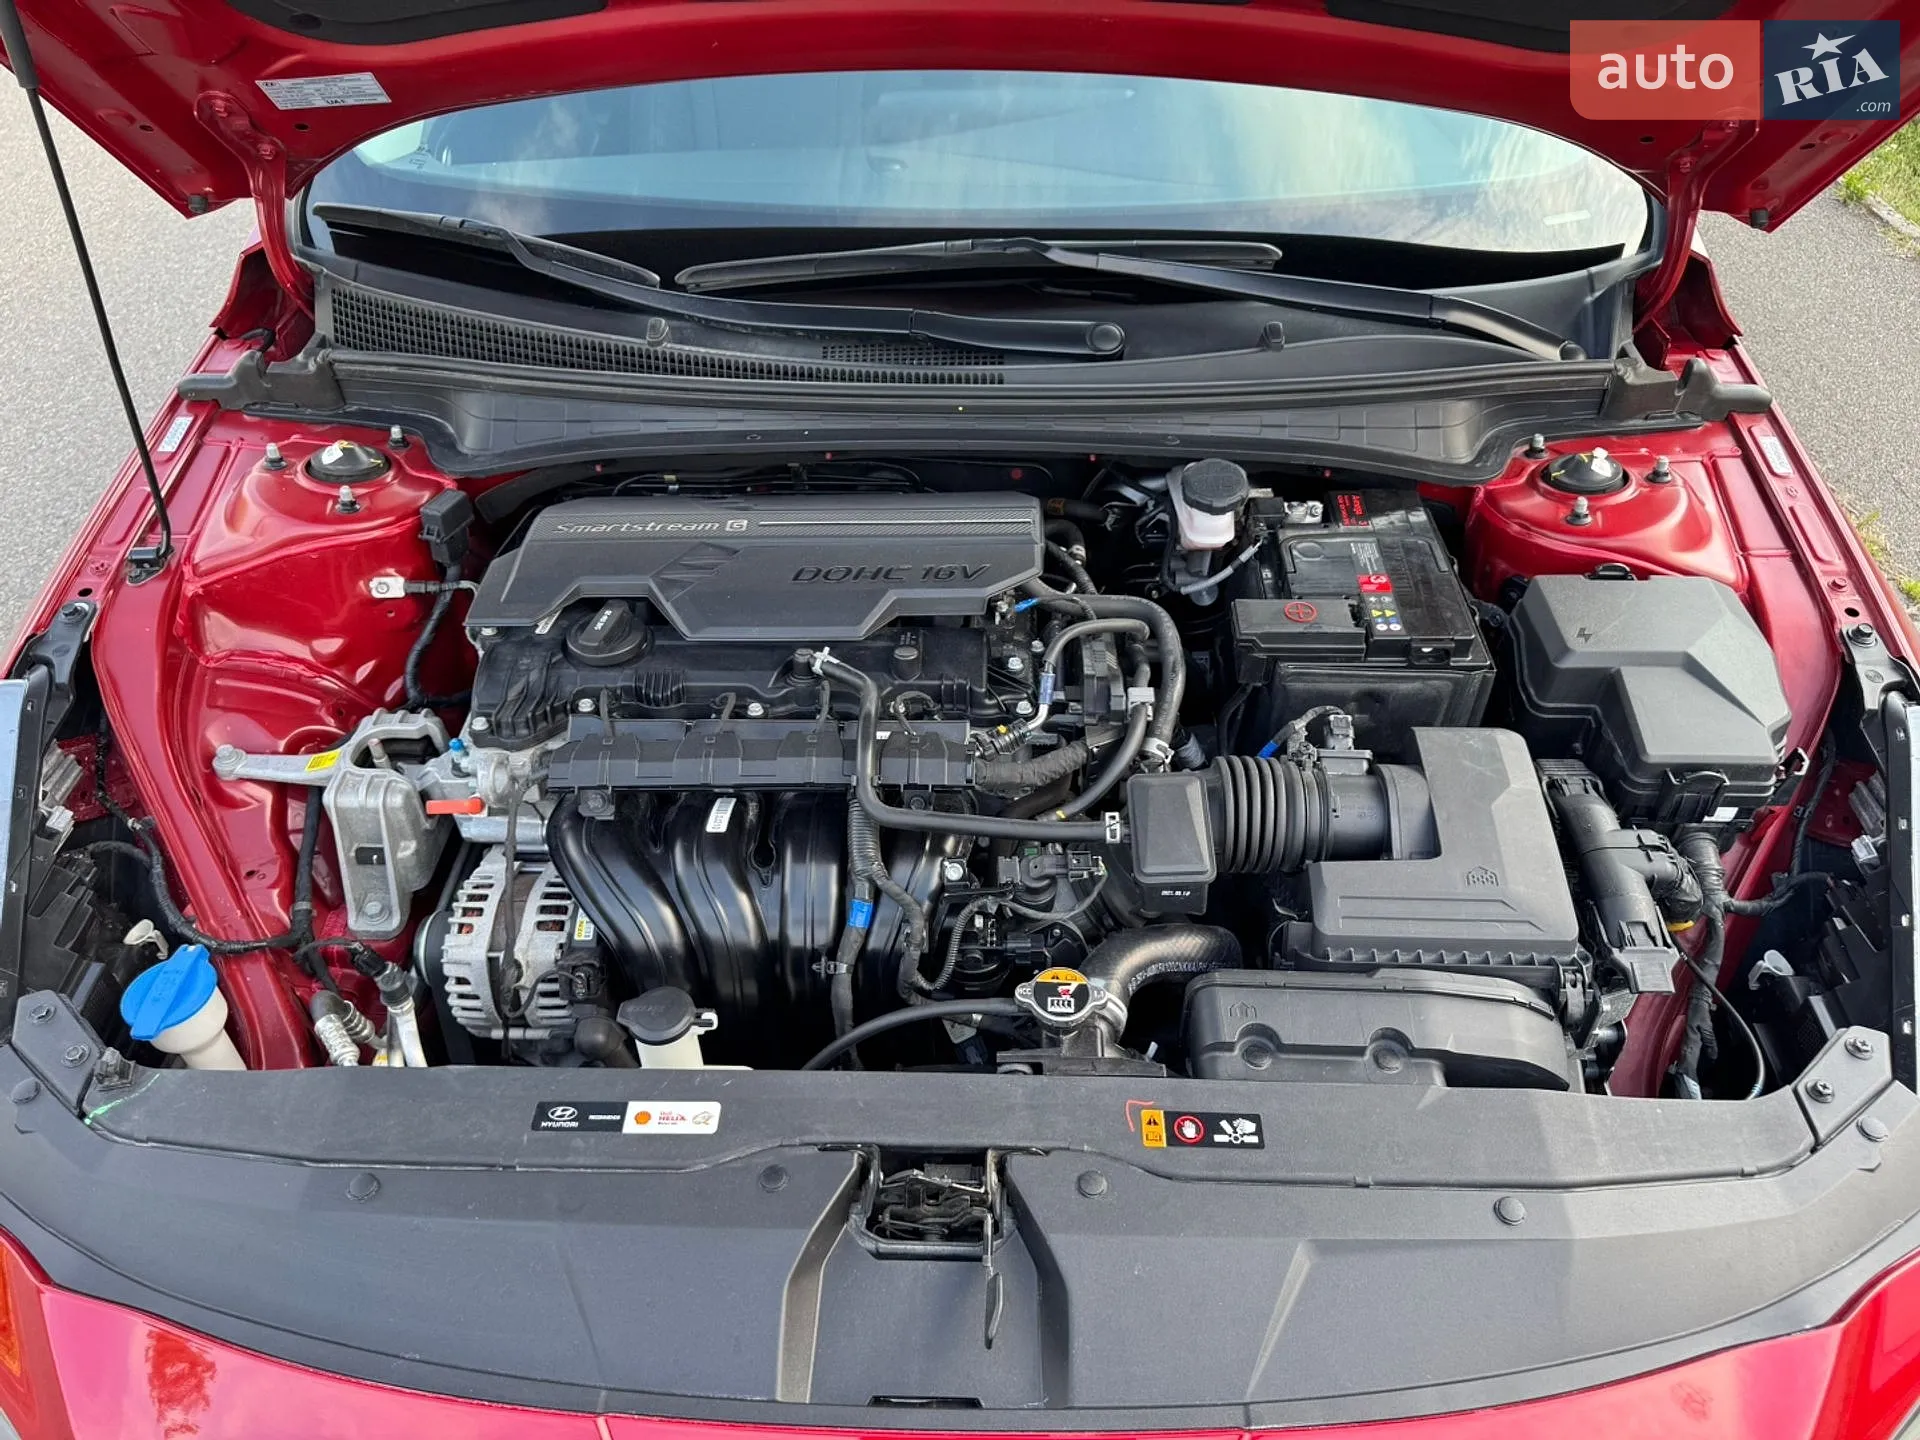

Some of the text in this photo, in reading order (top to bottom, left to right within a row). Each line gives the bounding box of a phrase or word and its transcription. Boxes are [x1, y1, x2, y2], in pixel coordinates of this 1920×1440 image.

[553, 520, 720, 534] Smartstream
[791, 563, 991, 583] DOHC 16V
